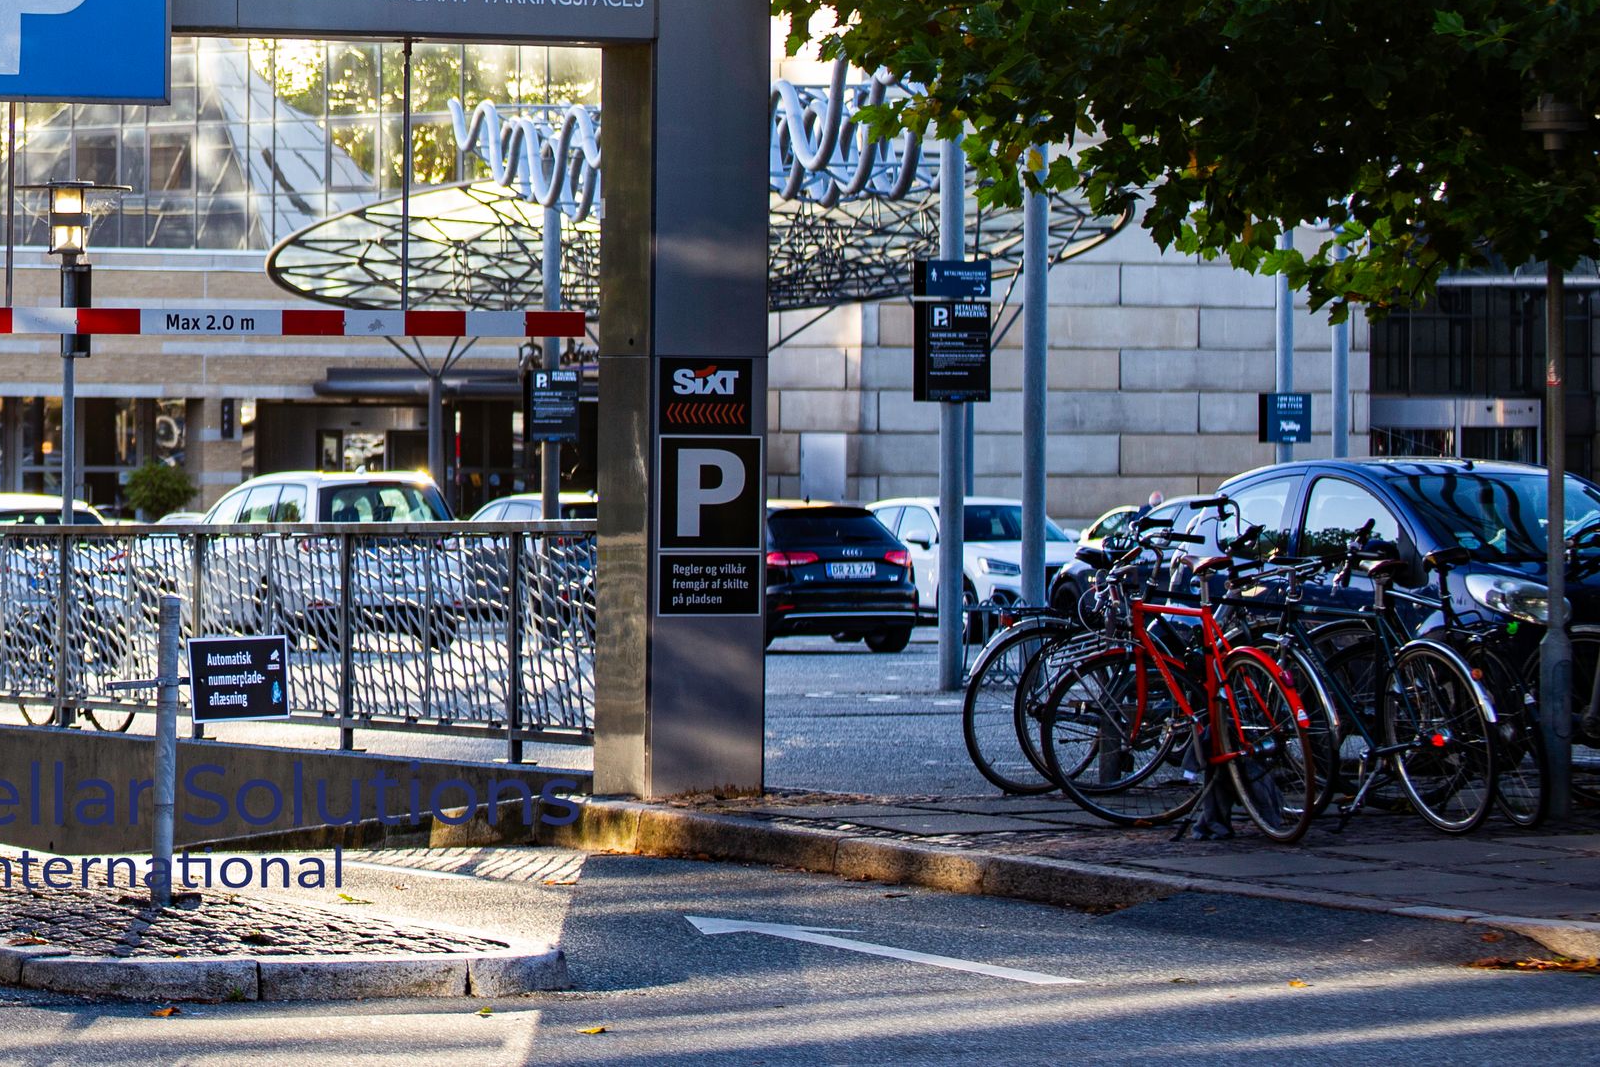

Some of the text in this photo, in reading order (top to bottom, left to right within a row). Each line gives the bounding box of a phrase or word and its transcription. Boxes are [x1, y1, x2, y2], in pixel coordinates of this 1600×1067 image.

[166, 313, 255, 331] Max 2.0 m
[676, 448, 746, 537] P
[672, 563, 747, 576] Regler og vilkår
[672, 578, 749, 591] fremgår af skilte
[672, 593, 723, 606] på pladsen
[207, 651, 252, 666] Automatisk
[208, 671, 266, 687] nummerplade-
[209, 691, 248, 707] aflæsning
